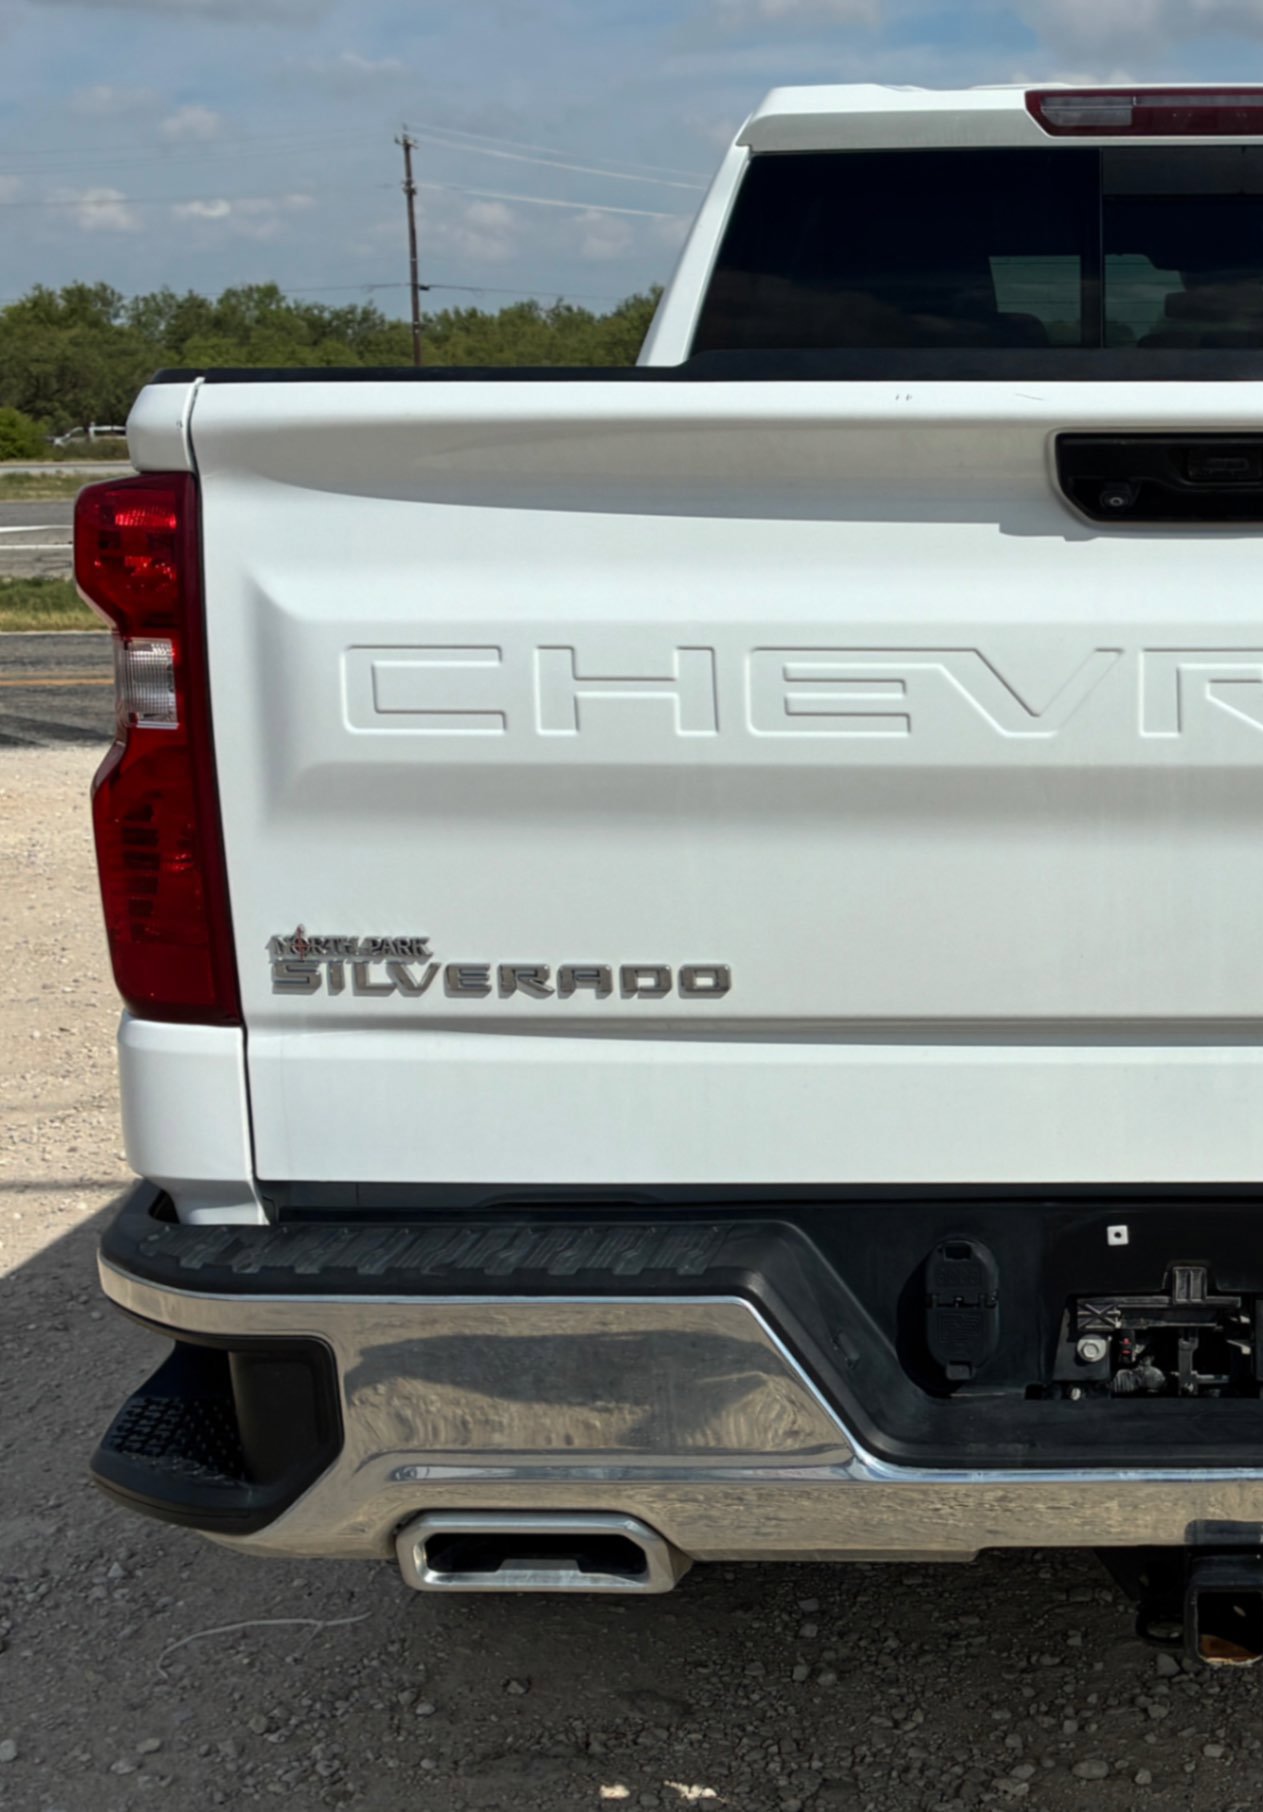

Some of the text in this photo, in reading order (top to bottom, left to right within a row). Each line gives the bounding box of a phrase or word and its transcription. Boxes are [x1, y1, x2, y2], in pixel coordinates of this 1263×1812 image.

[267, 932, 433, 963] NORTH PARK
[271, 959, 732, 998] SILVERADO
